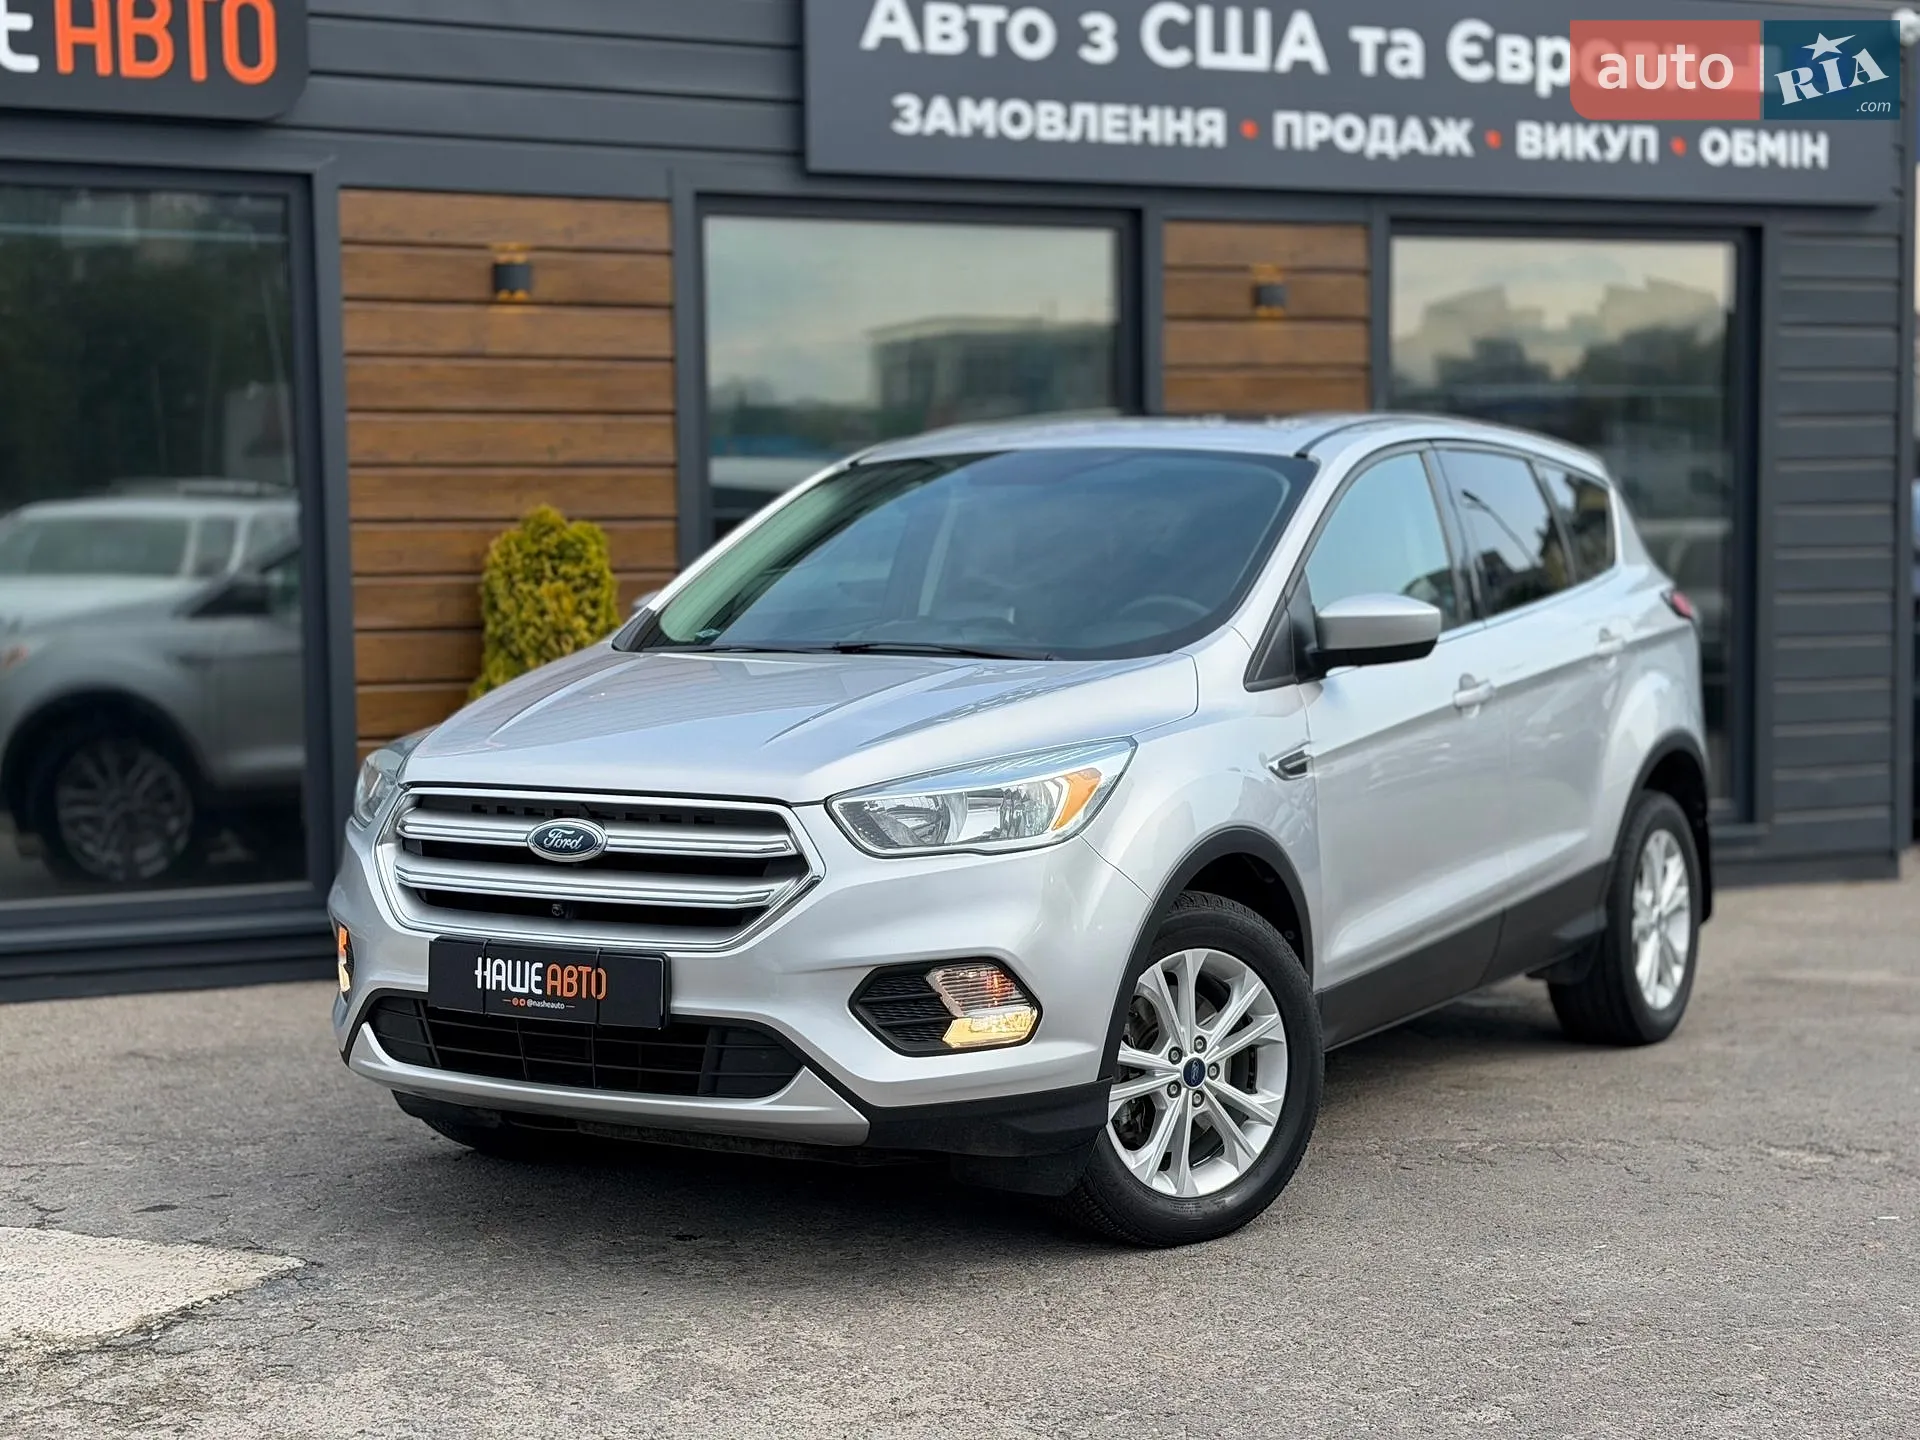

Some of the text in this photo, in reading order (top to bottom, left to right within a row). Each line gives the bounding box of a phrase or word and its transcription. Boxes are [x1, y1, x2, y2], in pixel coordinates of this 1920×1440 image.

[860, 0, 1057, 61] Авто
[1140, 1, 1330, 74] США
[1349, 26, 1425, 79] та
[892, 93, 1829, 168] ЗАМОВЛЕННЯ ПРОДАЖ ВИКУП ОБМІН
[543, 828, 584, 850] Ford
